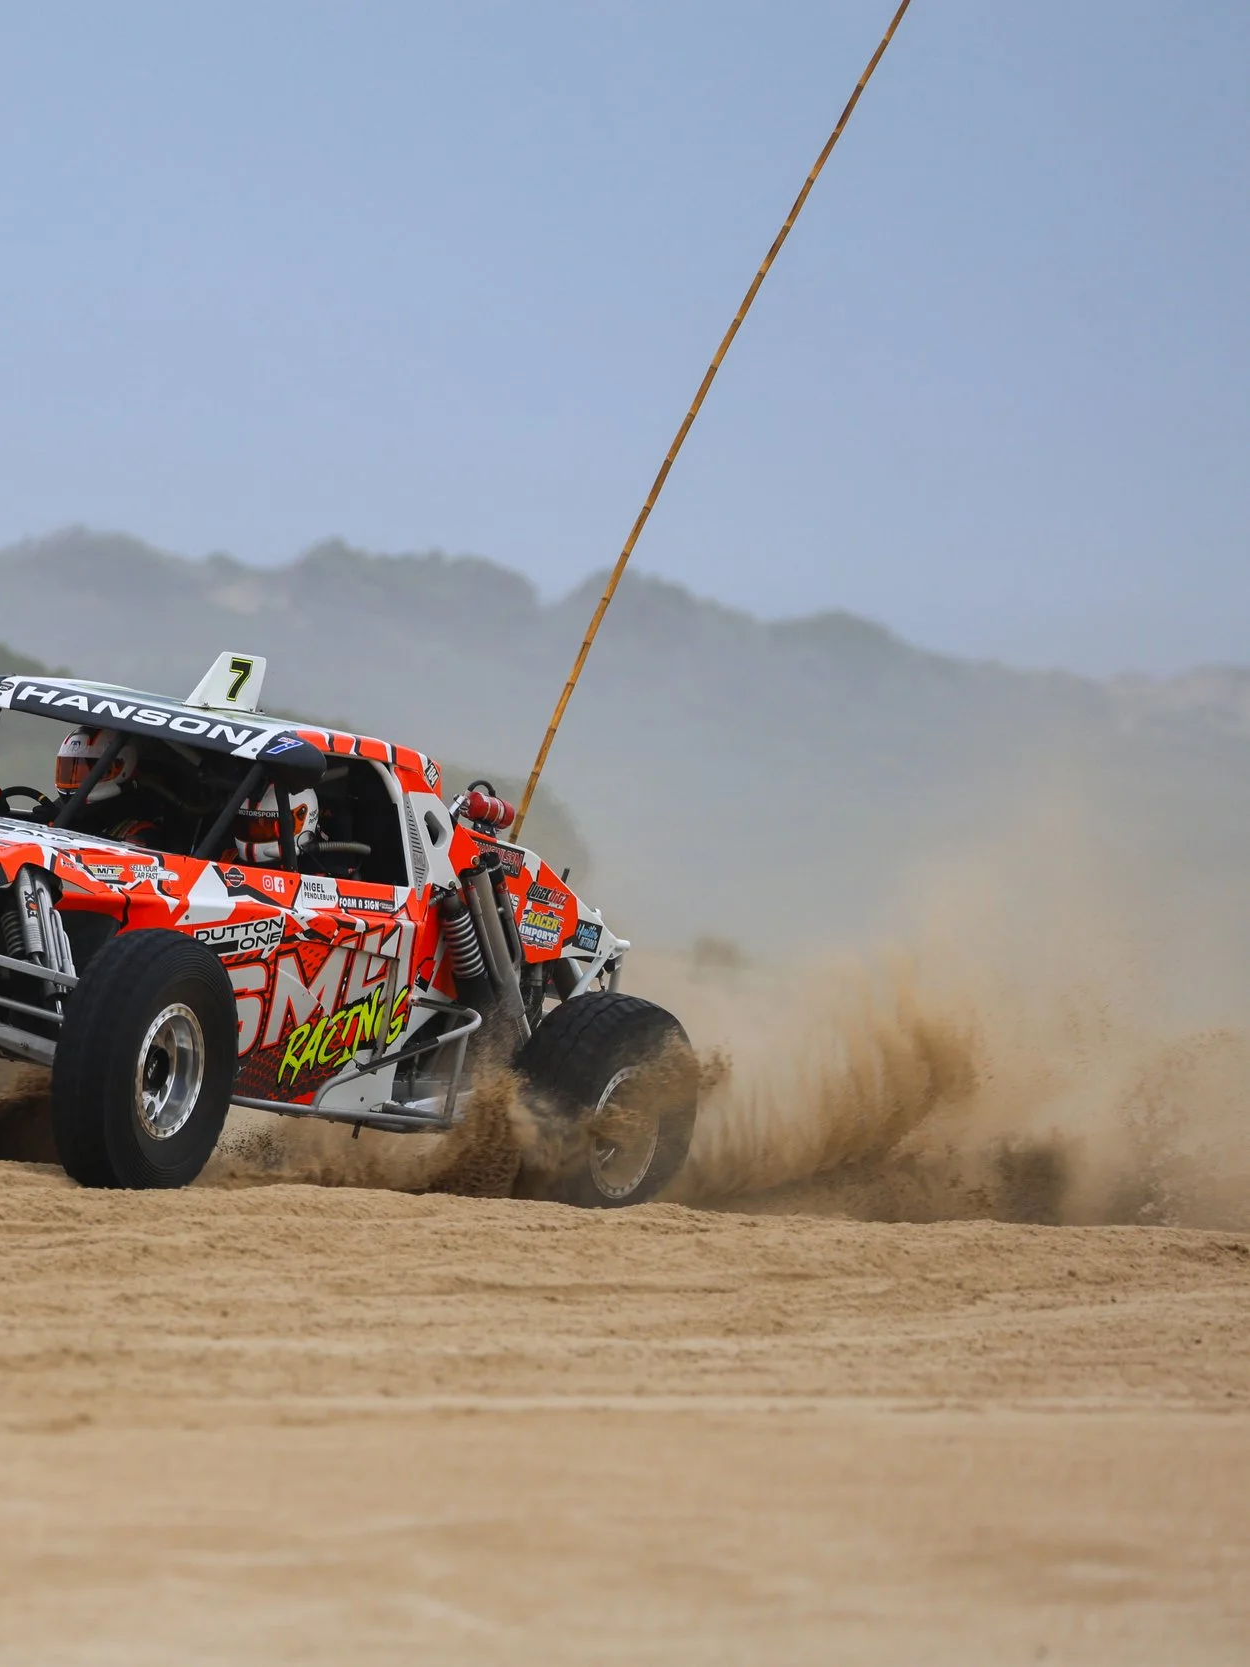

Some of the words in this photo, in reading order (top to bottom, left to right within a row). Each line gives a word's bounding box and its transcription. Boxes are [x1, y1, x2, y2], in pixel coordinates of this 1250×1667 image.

[227, 657, 253, 702] 7
[16, 686, 253, 745] HANSON
[426, 764, 439, 786] 184
[133, 871, 147, 880] CAR
[146, 871, 159, 880] FAST
[303, 882, 325, 893] NIGEL
[304, 891, 336, 902] PENDLEBURY
[24, 890, 38, 919] FOX
[339, 897, 357, 908] FORM
[358, 899, 363, 908] A
[364, 900, 380, 911] SIGN
[196, 916, 284, 941] DUTTON
[525, 911, 559, 931] RACER
[240, 931, 281, 950] ONE
[520, 925, 559, 943] IMPORTS
[277, 986, 409, 1086] RACING
